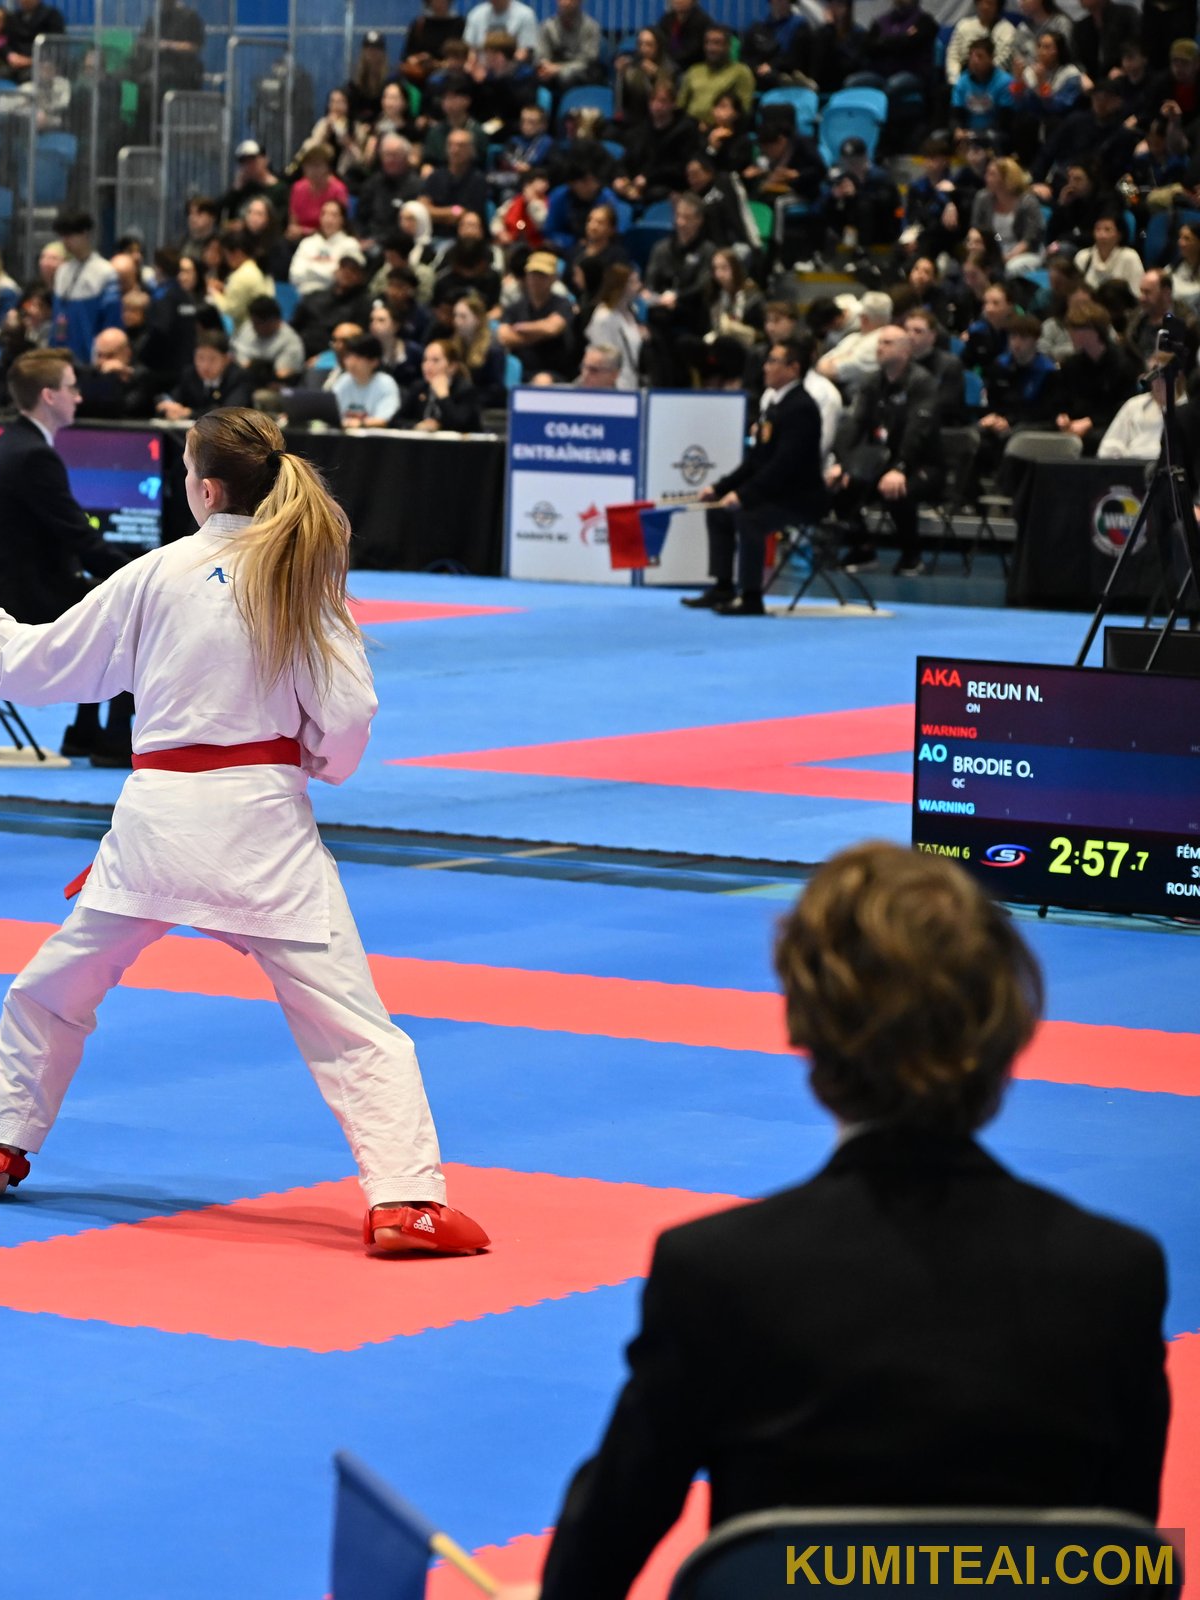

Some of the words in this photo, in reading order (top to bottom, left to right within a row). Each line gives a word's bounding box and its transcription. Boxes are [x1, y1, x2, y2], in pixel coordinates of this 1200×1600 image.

[544, 420, 604, 440] COACH
[921, 668, 961, 688] AKA
[967, 681, 1021, 701] REKUN
[1026, 685, 1043, 702] N.
[966, 703, 980, 713] ON
[921, 724, 977, 739] WARNING
[918, 743, 947, 762] AO
[953, 756, 1012, 776] BRODIE
[1016, 761, 1034, 778] O.
[951, 778, 965, 788] QC
[918, 799, 975, 815] WARNING
[918, 843, 959, 858] TATAMI
[962, 847, 971, 859] 6
[1191, 865, 1200, 878] S
